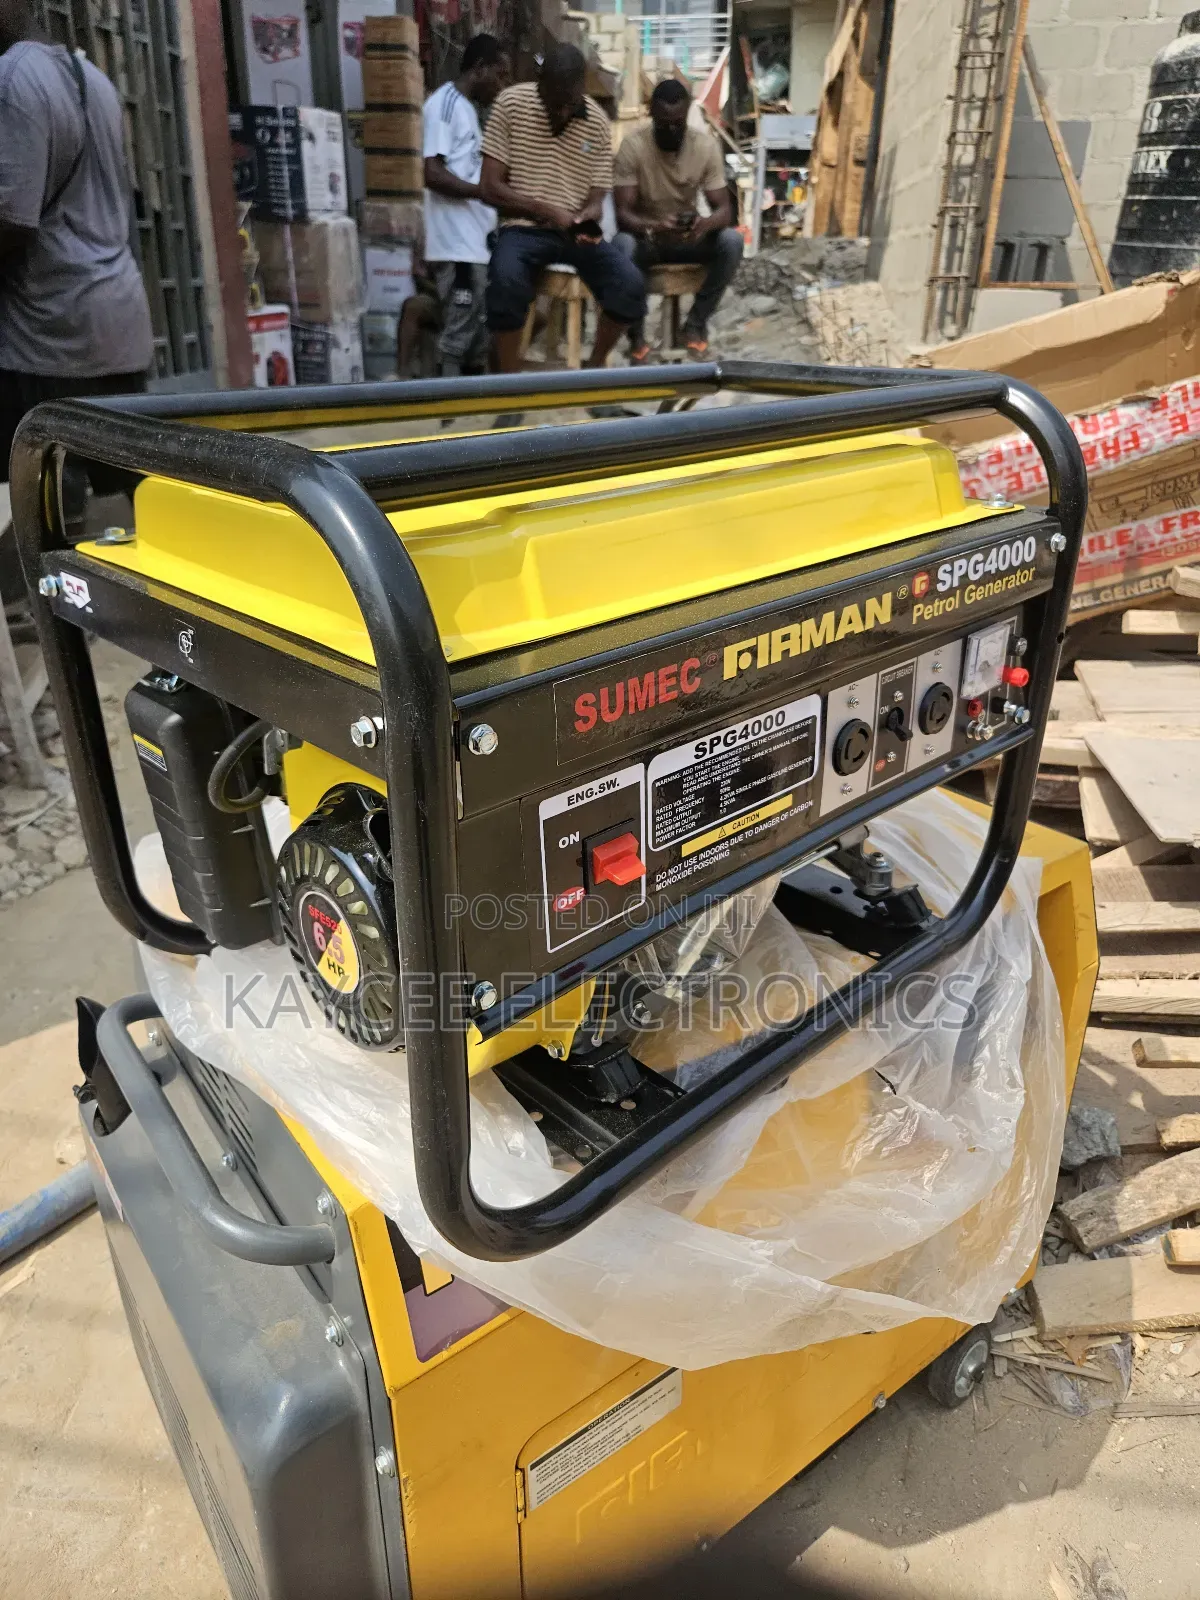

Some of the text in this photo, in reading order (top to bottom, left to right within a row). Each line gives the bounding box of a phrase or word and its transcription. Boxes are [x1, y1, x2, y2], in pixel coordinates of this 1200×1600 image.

[936, 536, 1036, 592] SPG4000
[911, 566, 1036, 625] Petrol Generator
[574, 657, 701, 733] SUMEC
[723, 591, 892, 681] FIRMAN
[879, 705, 889, 715] ON
[693, 710, 786, 760] SPG4000
[682, 767, 694, 777] ADD
[694, 762, 705, 772] THE
[705, 747, 743, 769] RECOMMENDED
[759, 736, 768, 746] THE
[682, 779, 697, 789] READ
[697, 774, 709, 783] AND
[709, 760, 741, 778] UNDERSTAND
[772, 739, 791, 751] MANUAL
[682, 774, 694, 783] YOU
[695, 767, 711, 778] START
[711, 763, 721, 772] THE
[682, 779, 712, 796] OPERATING
[712, 774, 722, 783] THE
[566, 777, 620, 807] ENG.SW.
[655, 818, 673, 831] RATED
[672, 809, 693, 822] OUTPUT
[735, 782, 752, 795] SINGLE
[751, 775, 767, 787] PHASE
[767, 766, 788, 781] GASOLINE
[788, 756, 813, 771] GENERATOR
[655, 803, 673, 816] RATED
[673, 793, 695, 808] VOLTAGE
[655, 811, 673, 823] RATED
[675, 796, 705, 814] FREQUENCY
[732, 812, 760, 830] CAUTION
[655, 822, 681, 837] MAXIMUM
[681, 812, 702, 826] OUTPUT
[655, 831, 675, 844] POWER
[675, 821, 696, 834] FACTOR
[558, 831, 580, 849] ON
[655, 800, 813, 883] DO NOT USE INDOORS DUE TO DANGER OF CARBON
[655, 850, 730, 892] MONOXIDE POISONING
[556, 887, 585, 910] OFF
[327, 957, 346, 977] HP
[587, 1398, 631, 1431] OPERATION
